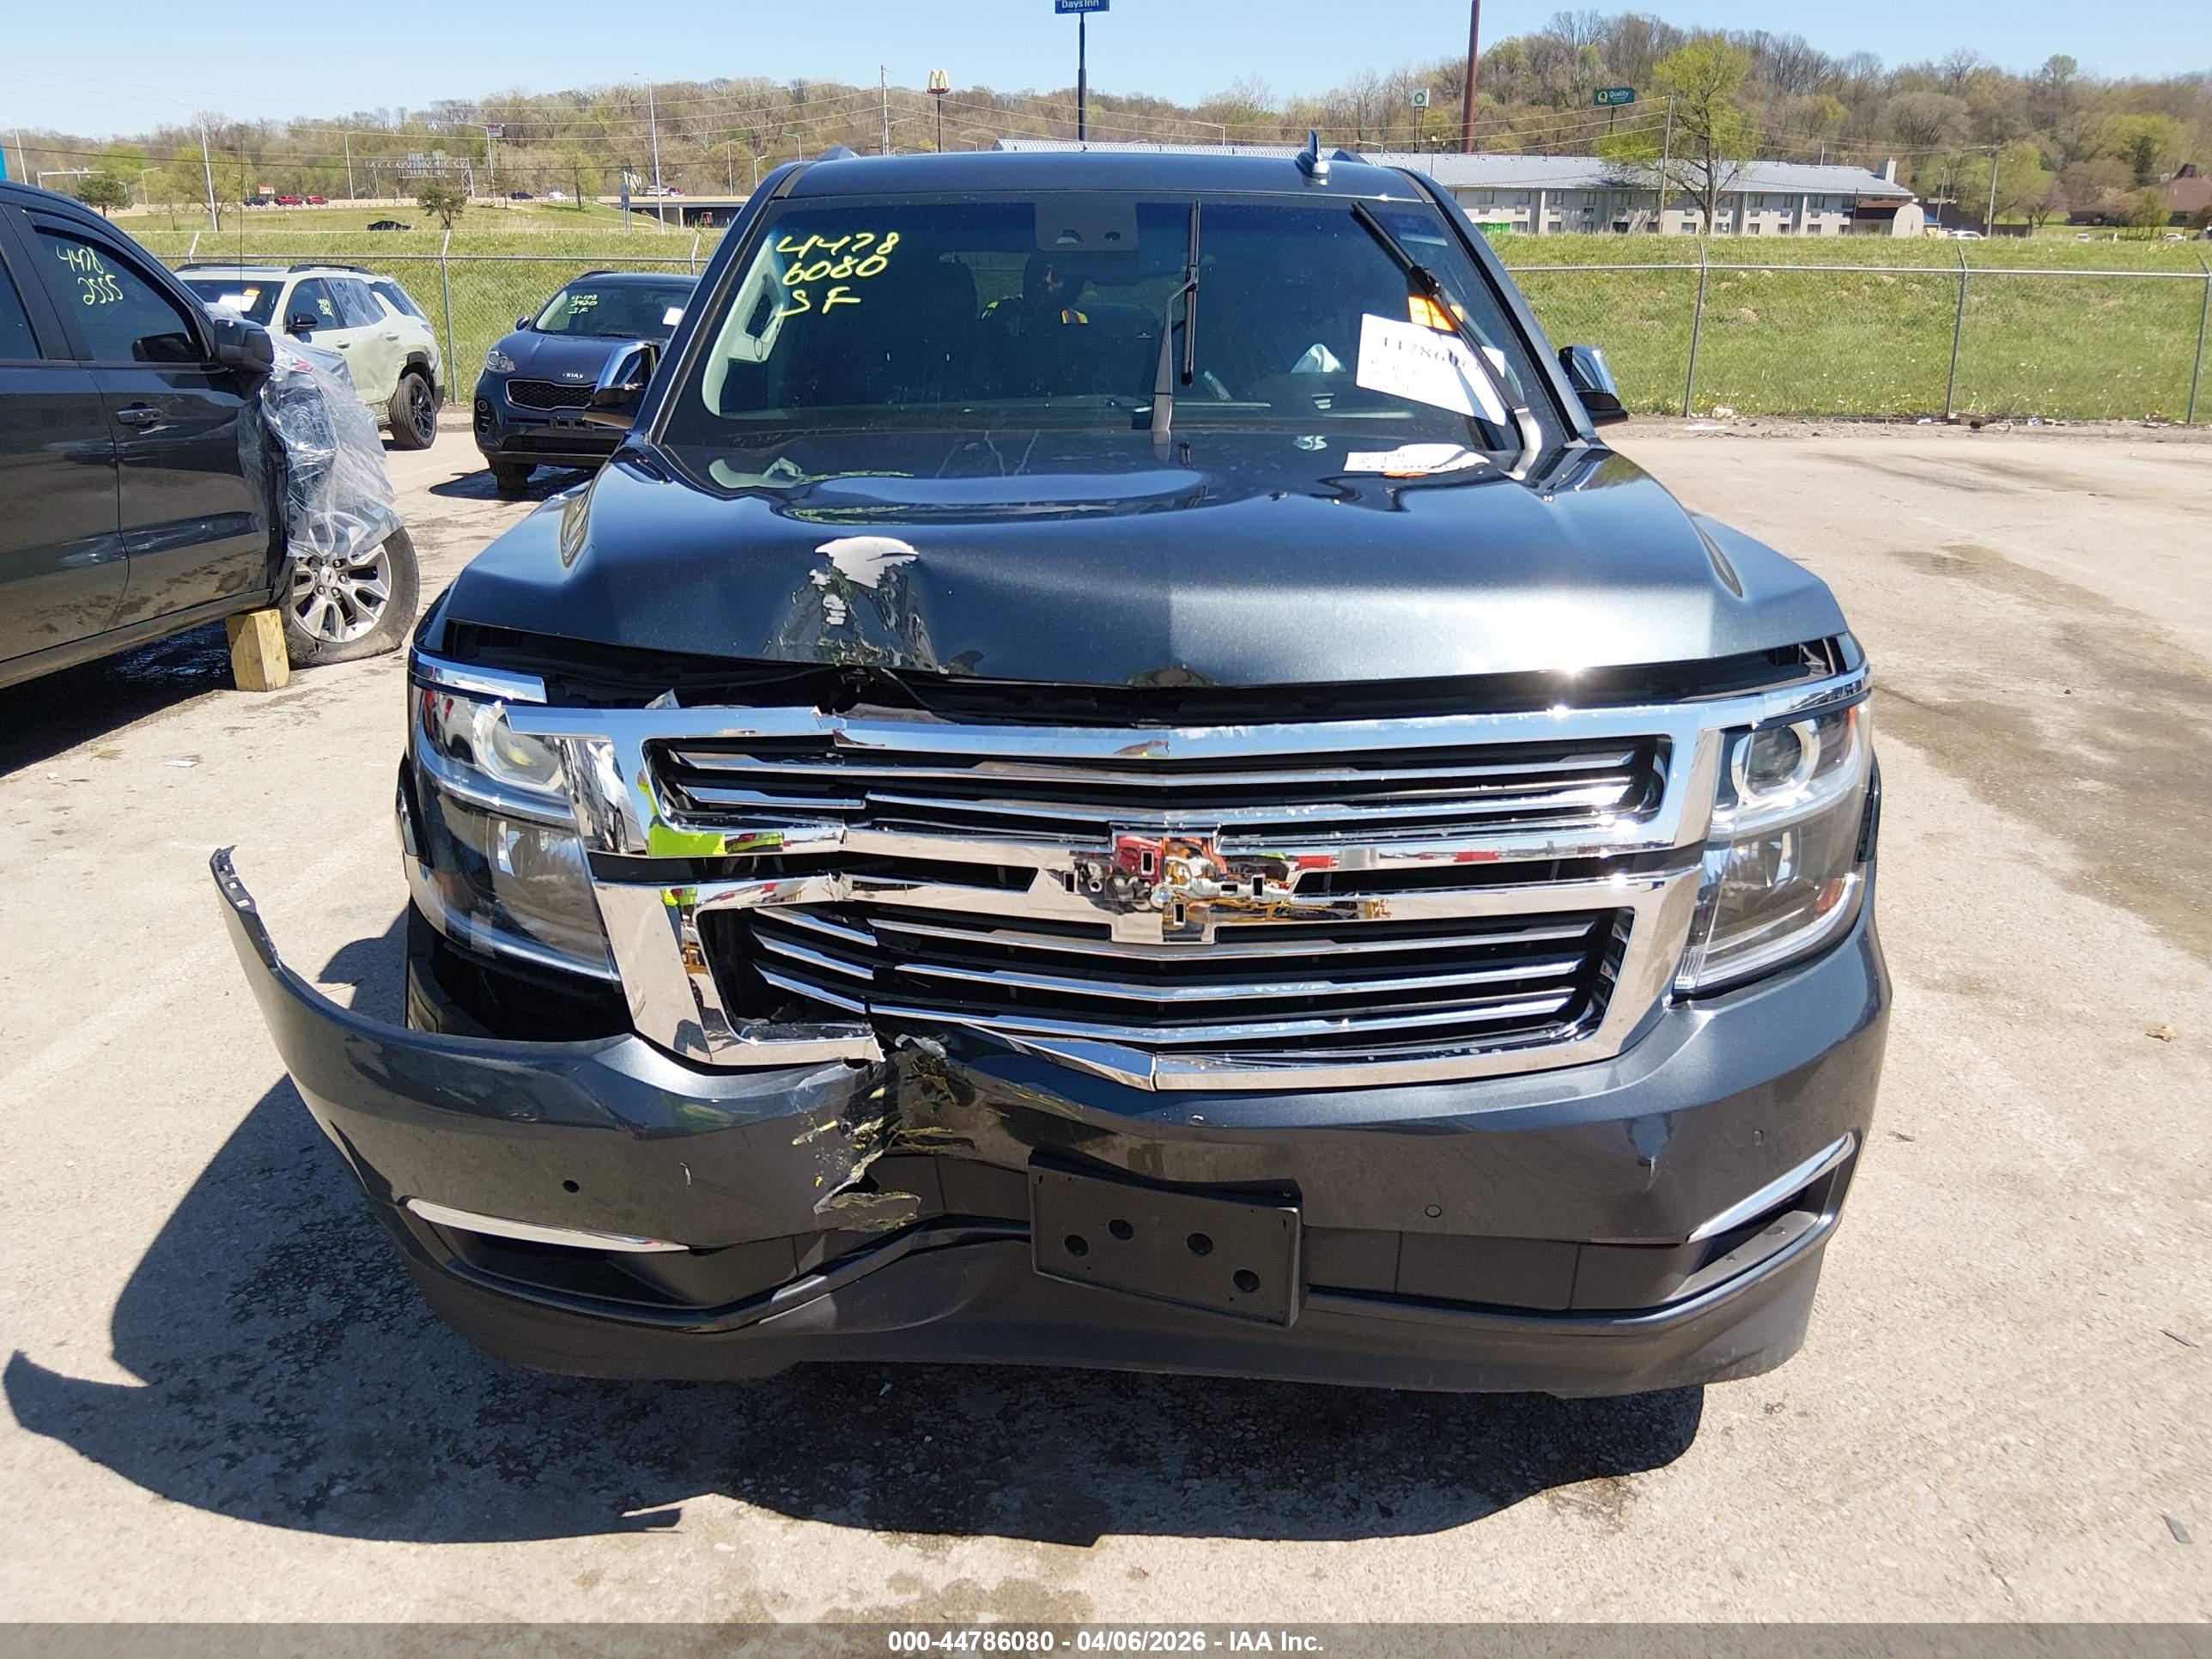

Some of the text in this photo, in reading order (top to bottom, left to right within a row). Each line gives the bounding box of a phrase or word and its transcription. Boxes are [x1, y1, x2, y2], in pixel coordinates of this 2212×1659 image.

[775, 231, 900, 258] 4478
[781, 254, 888, 286] 6080
[77, 274, 124, 306] 2555
